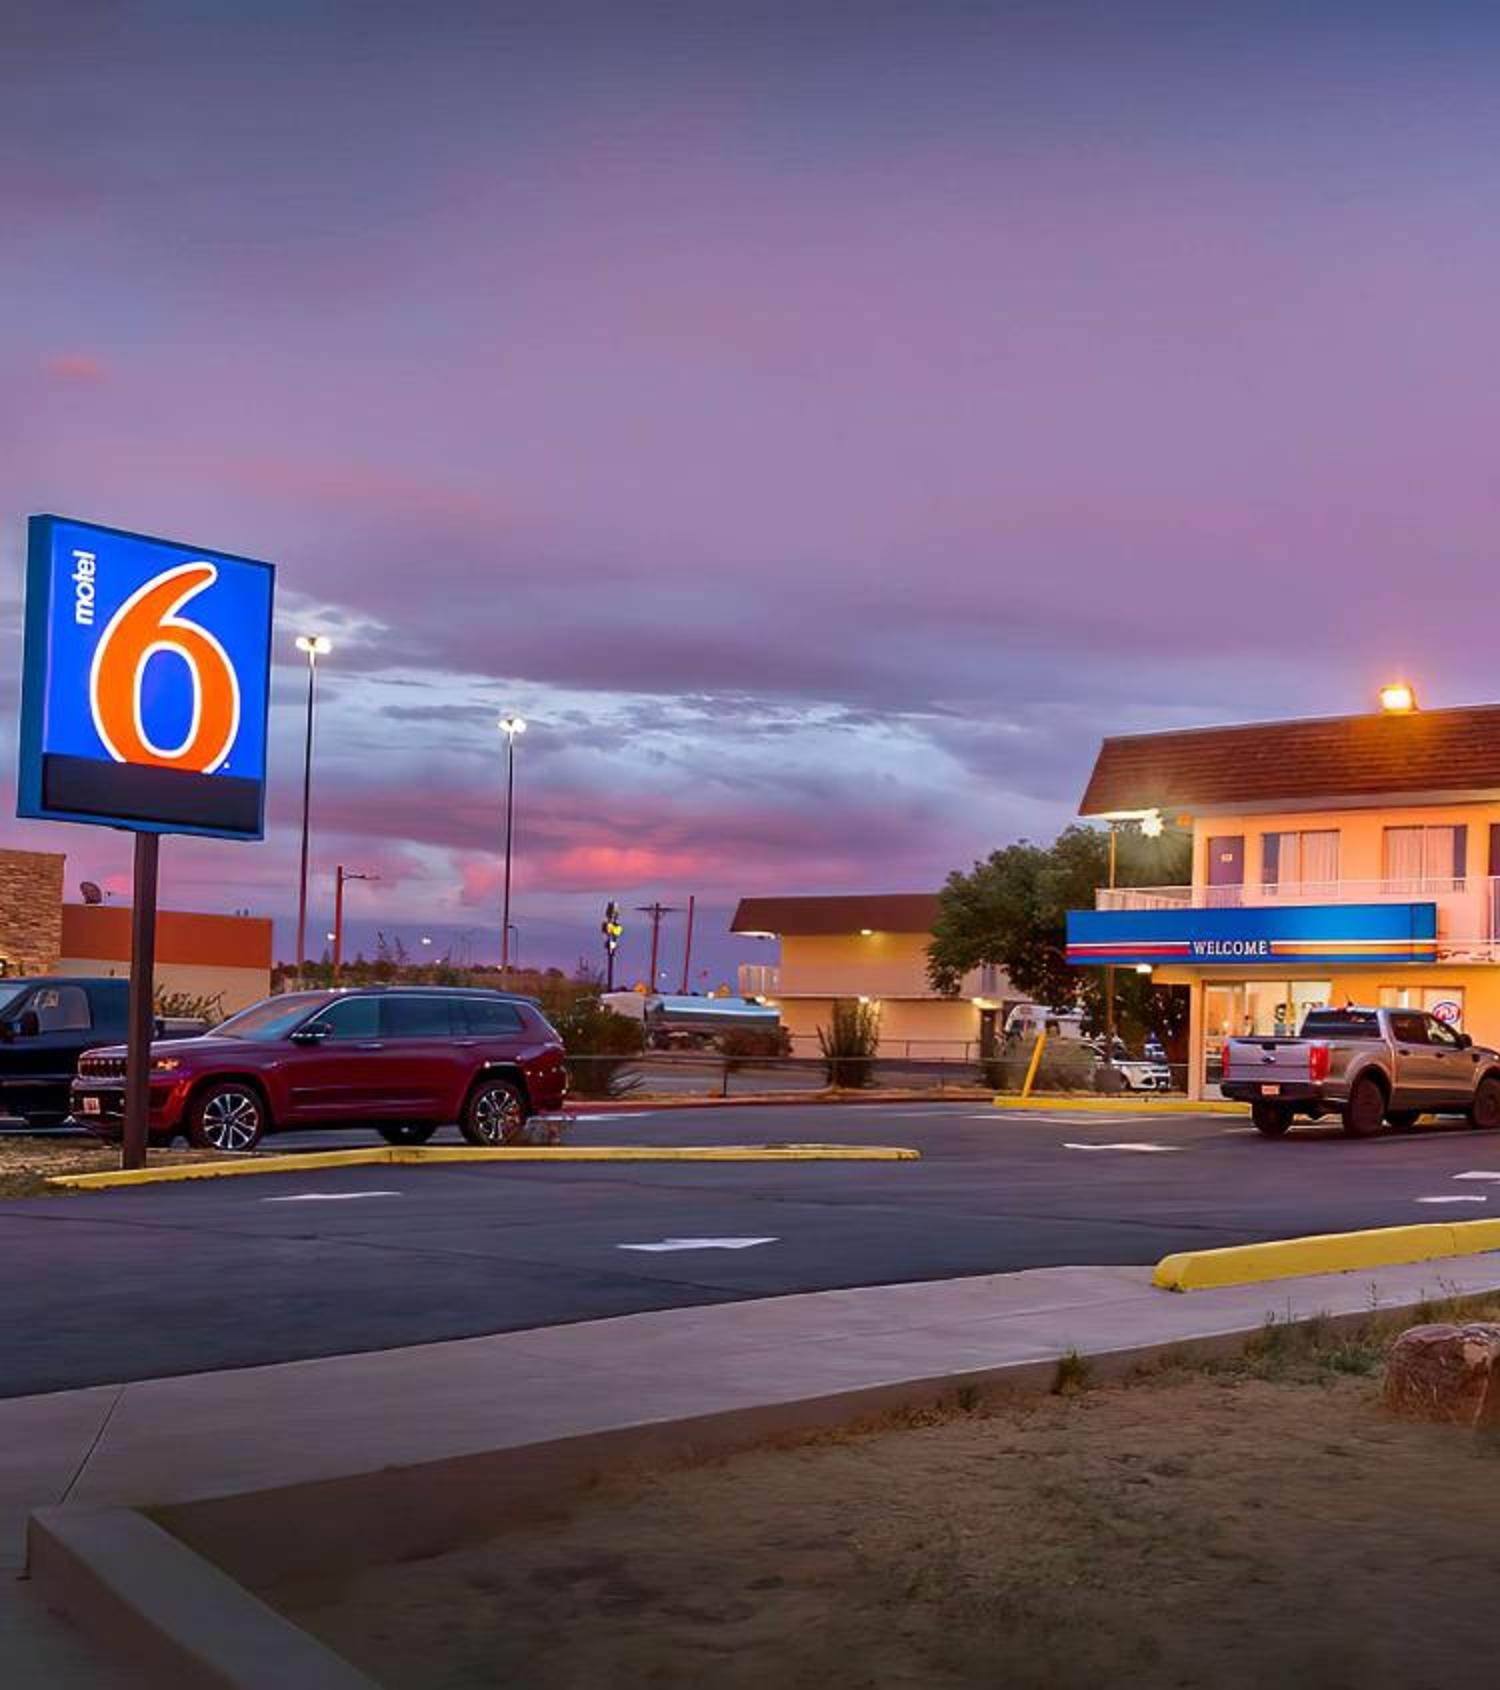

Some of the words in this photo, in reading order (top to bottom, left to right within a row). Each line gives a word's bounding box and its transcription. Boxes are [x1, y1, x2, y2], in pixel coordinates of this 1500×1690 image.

[72, 550, 96, 625] motel
[90, 561, 240, 774] 6
[1193, 940, 1268, 955] WELCOME
